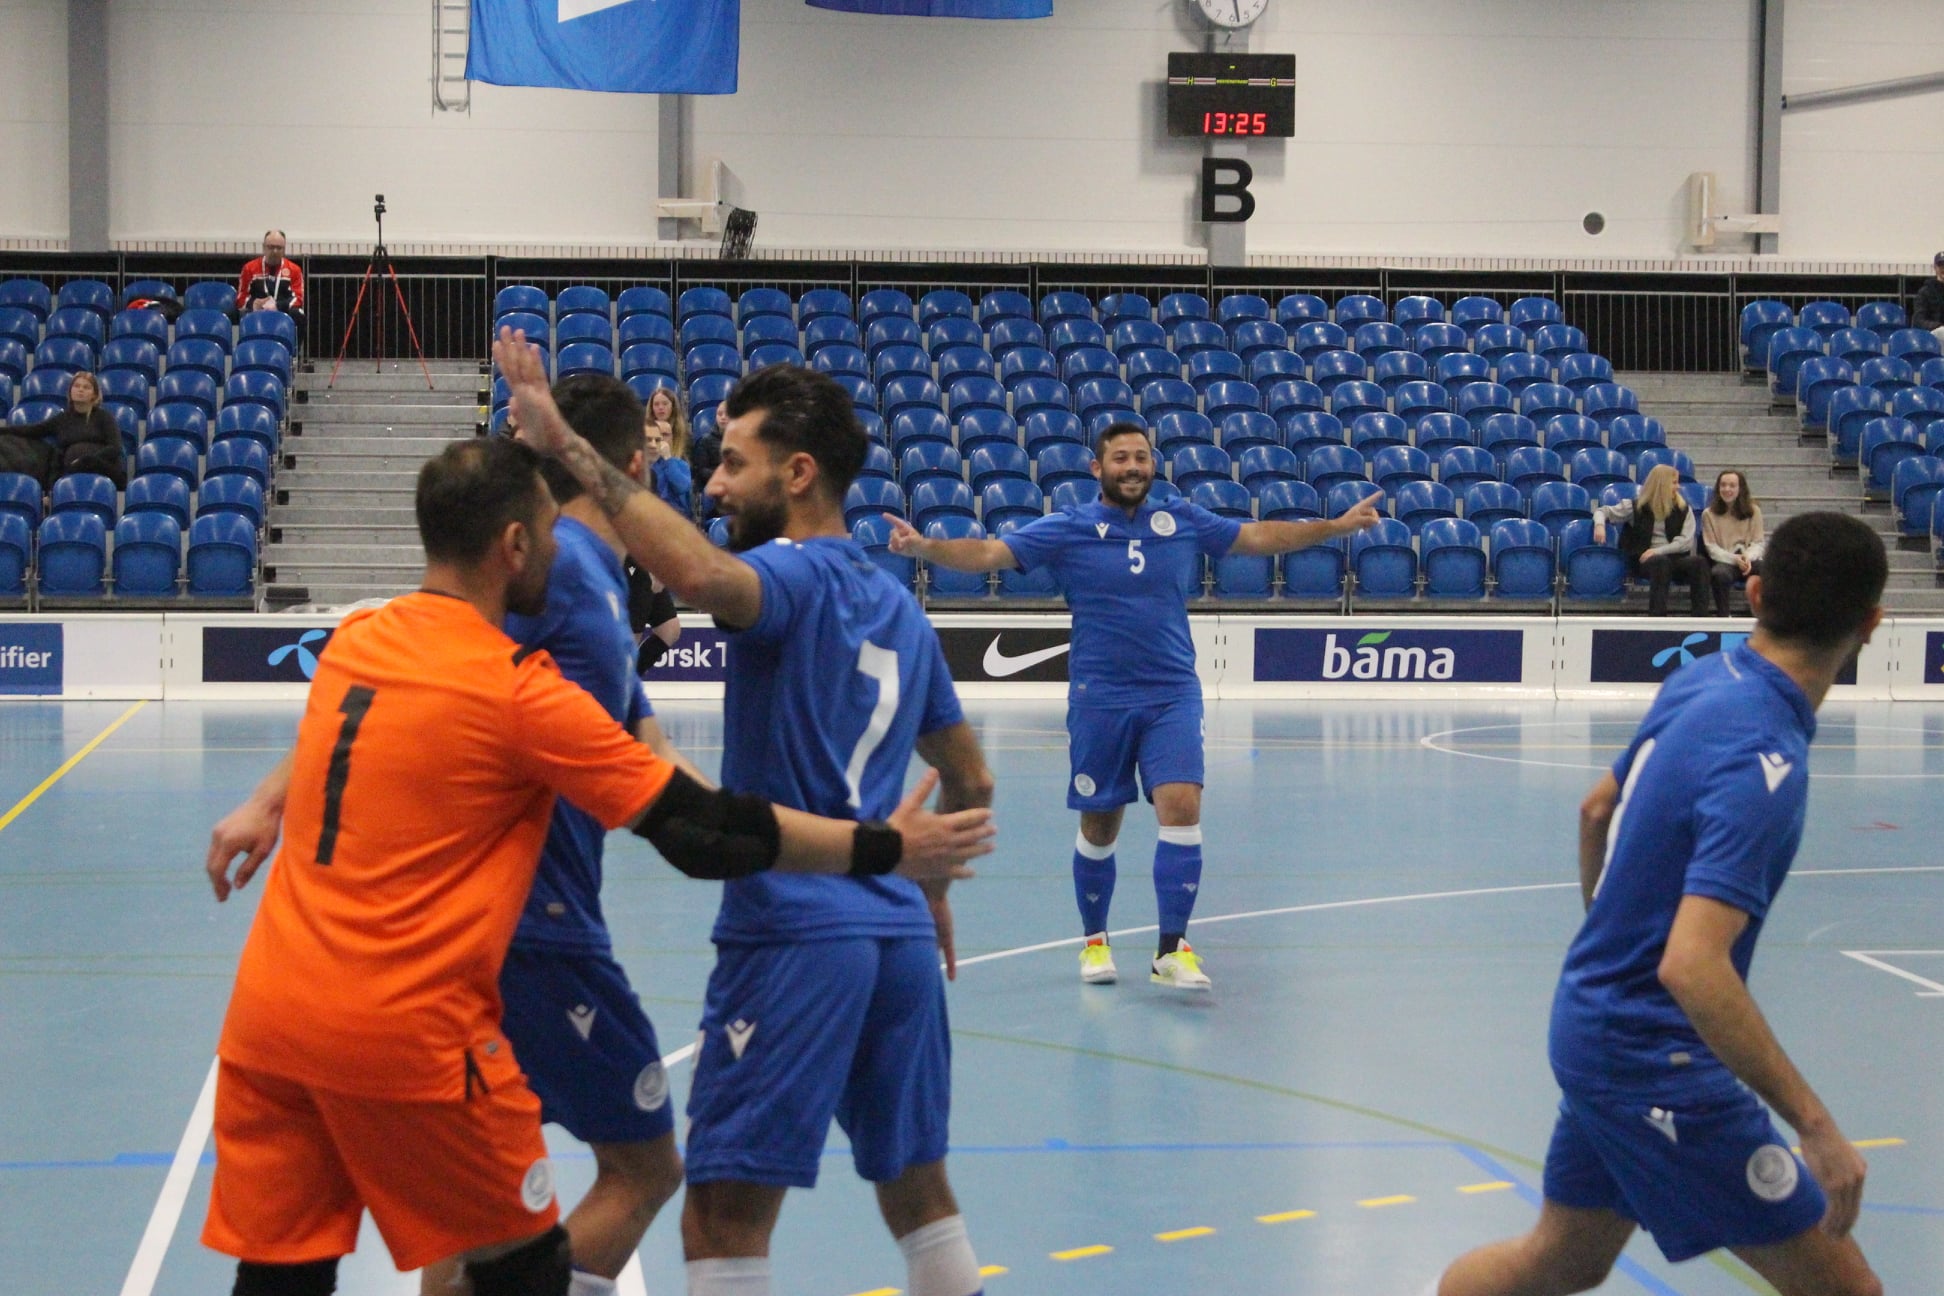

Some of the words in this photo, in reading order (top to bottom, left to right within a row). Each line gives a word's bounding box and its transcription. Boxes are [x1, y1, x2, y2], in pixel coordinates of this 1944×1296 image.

[1204, 112, 1266, 134] 13:25
[1202, 158, 1256, 222] B
[1128, 539, 1146, 575] 5
[1322, 633, 1455, 679] bama
[315, 684, 378, 866] 1
